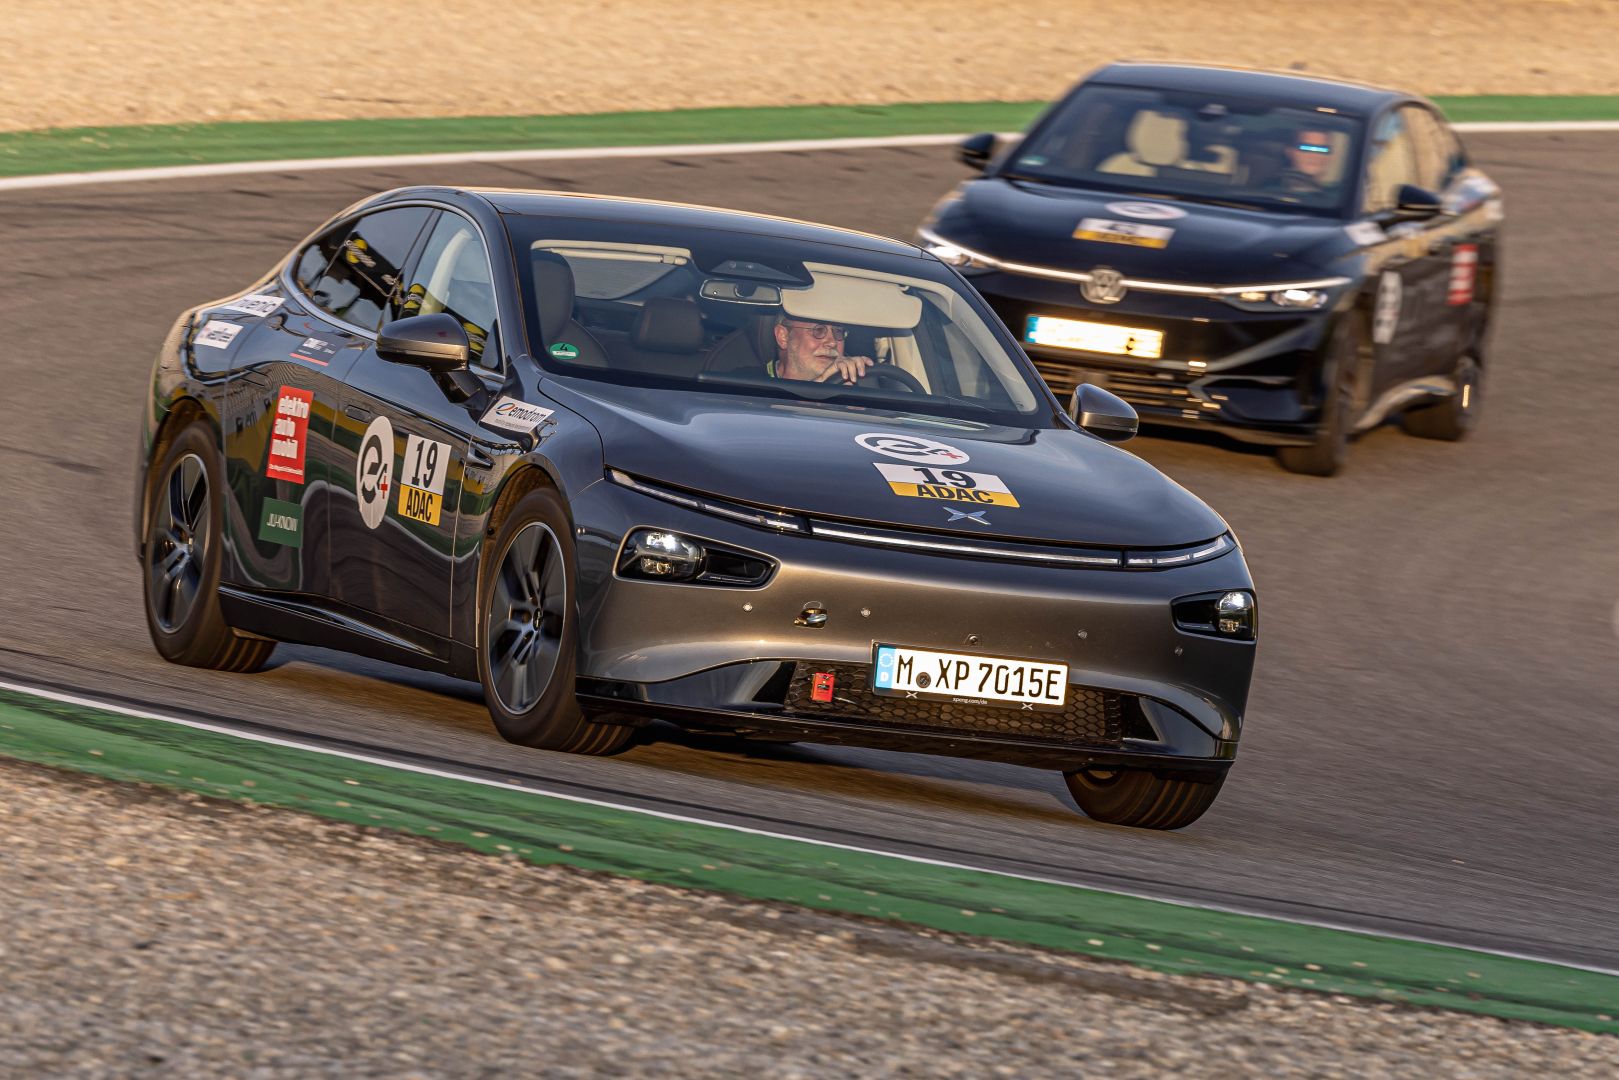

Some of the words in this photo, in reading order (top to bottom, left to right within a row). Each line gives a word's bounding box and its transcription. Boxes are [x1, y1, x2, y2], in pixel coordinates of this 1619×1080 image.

[411, 440, 438, 488] 19
[913, 467, 977, 489] 19
[405, 488, 433, 522] ADAC
[916, 484, 994, 504] ADAC
[896, 654, 914, 685] M
[935, 658, 970, 690] XP
[978, 662, 1061, 700] 7015E
